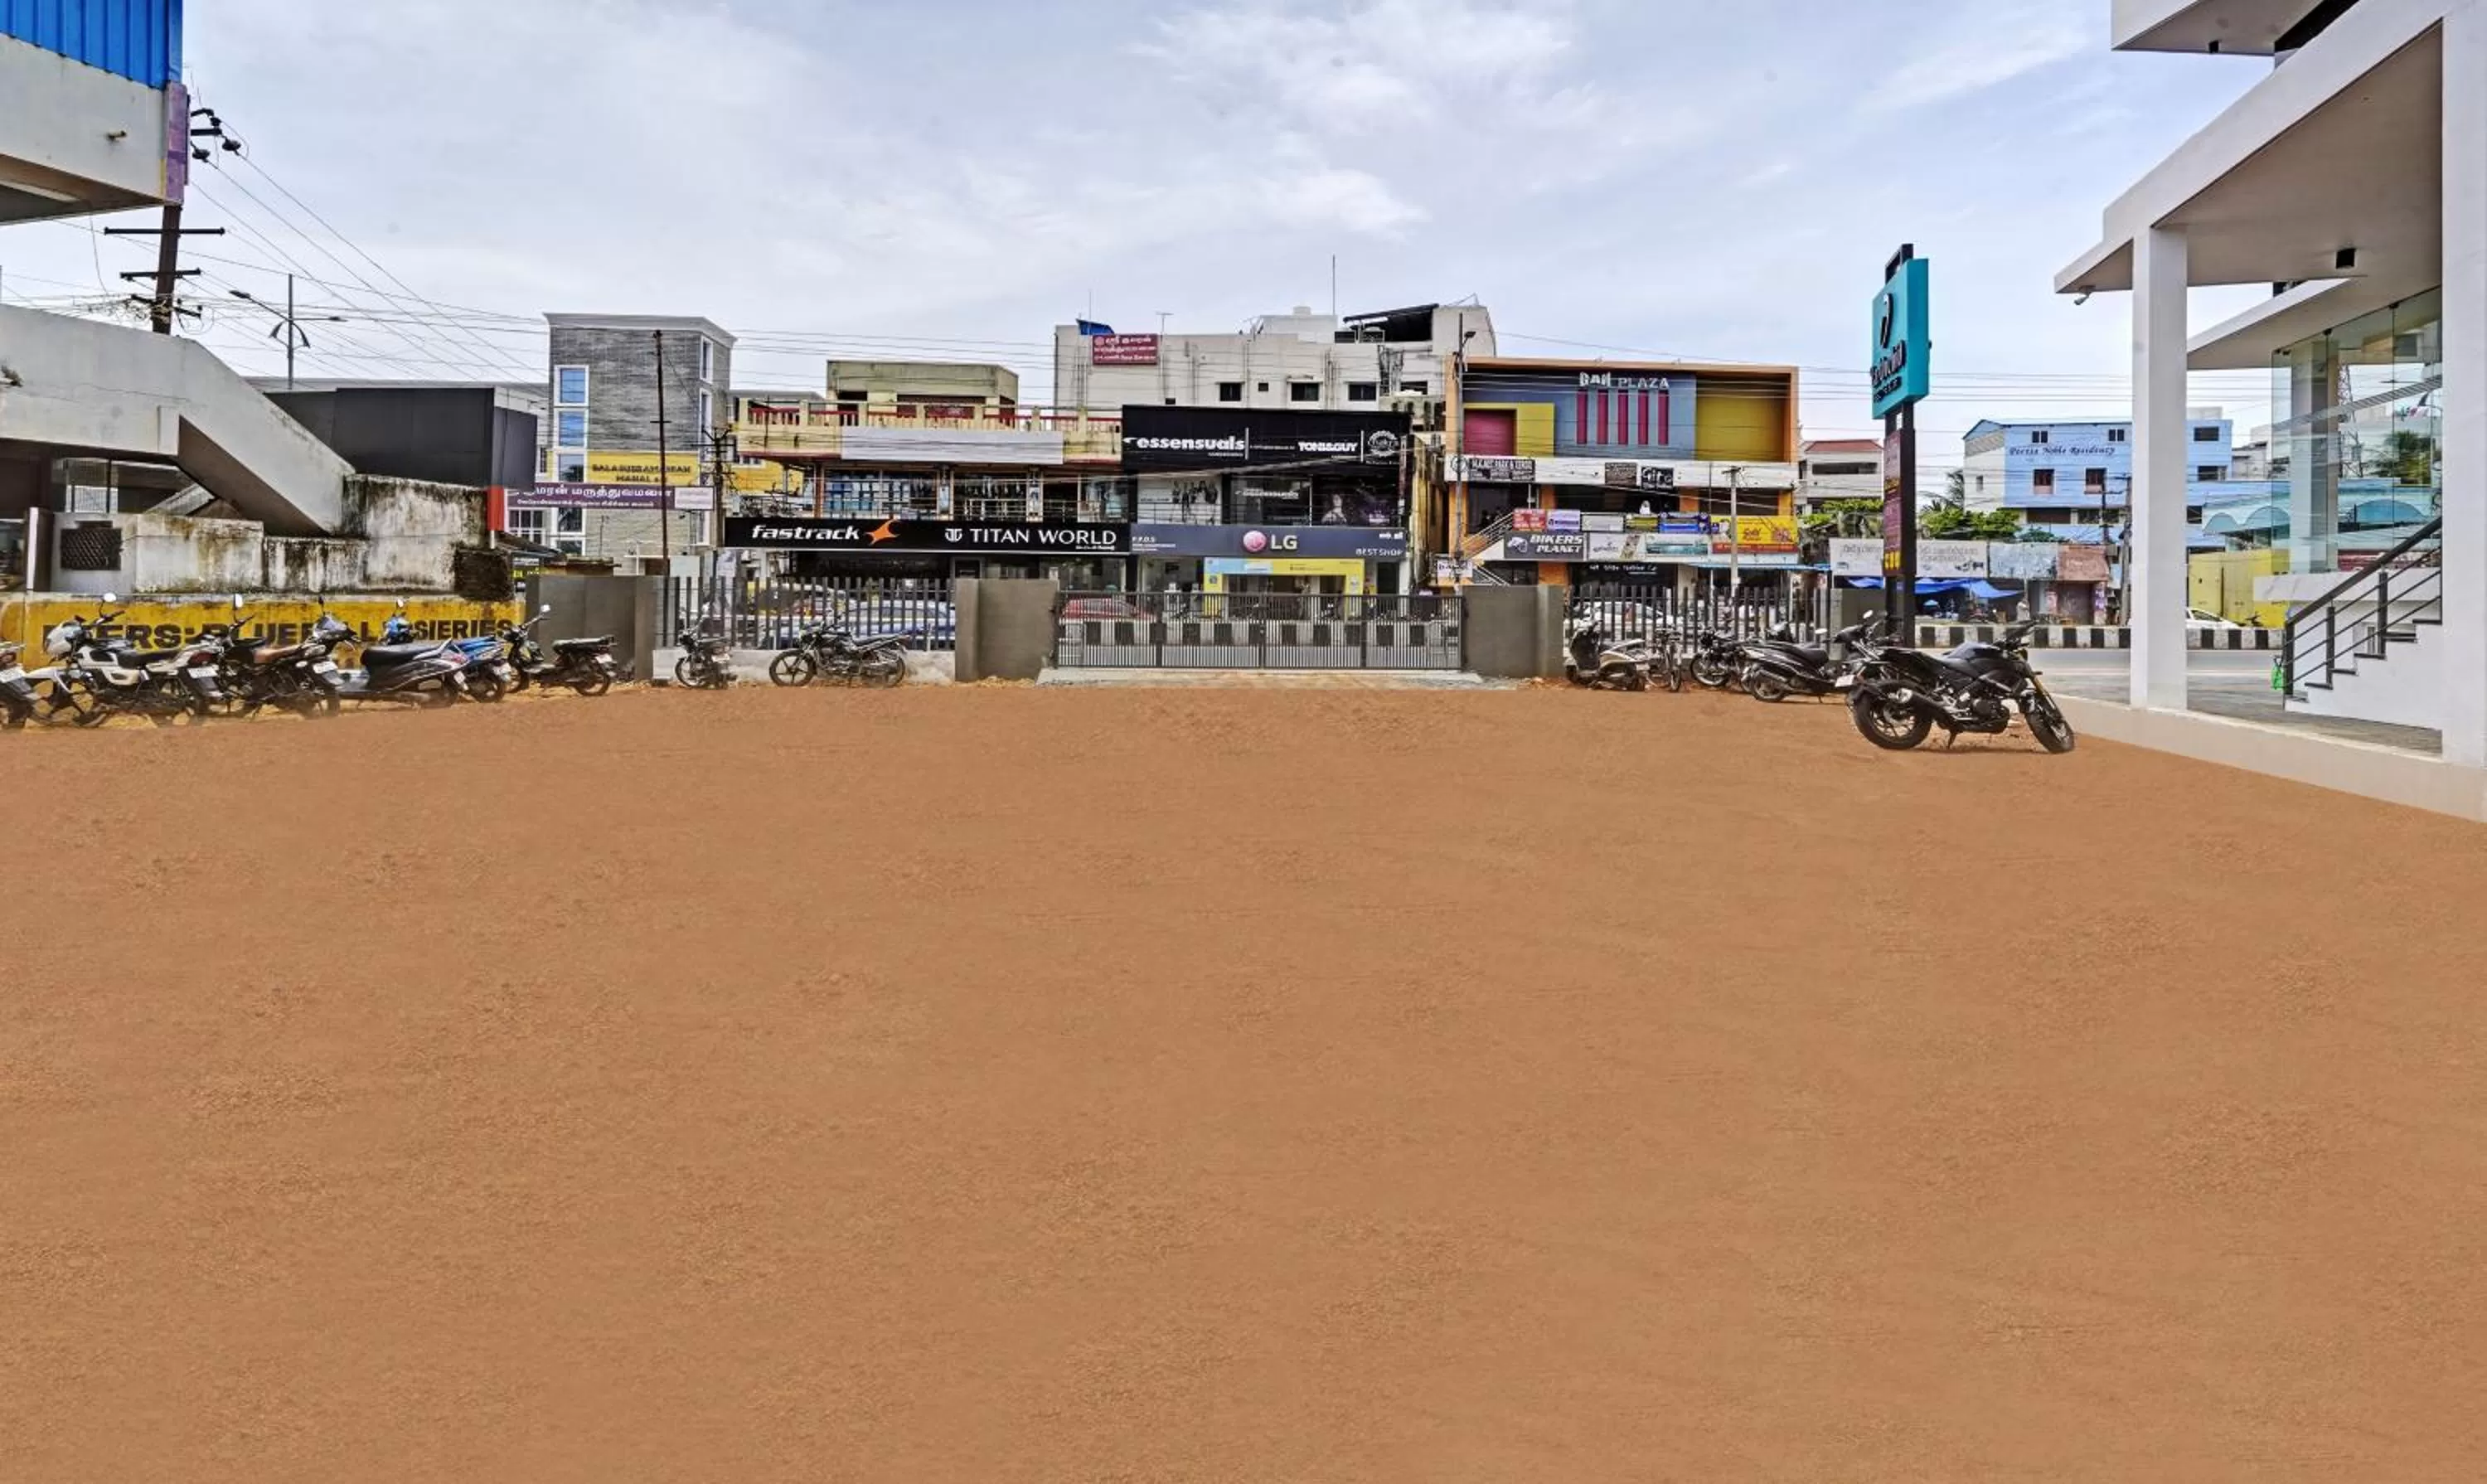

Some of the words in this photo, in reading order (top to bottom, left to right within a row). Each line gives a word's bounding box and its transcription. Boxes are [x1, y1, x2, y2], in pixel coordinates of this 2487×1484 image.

[1618, 377, 1670, 389] PLAZA
[1137, 435, 1244, 450] essensuals
[752, 524, 860, 540] fastrack
[970, 528, 1030, 543] TITAN
[1038, 529, 1116, 545] WORLD
[1270, 535, 1297, 550] LG
[1530, 534, 1583, 545] BIKERS
[1355, 547, 1378, 556] BEST
[1379, 547, 1403, 556] SHOP
[1536, 545, 1583, 554] PLANET
